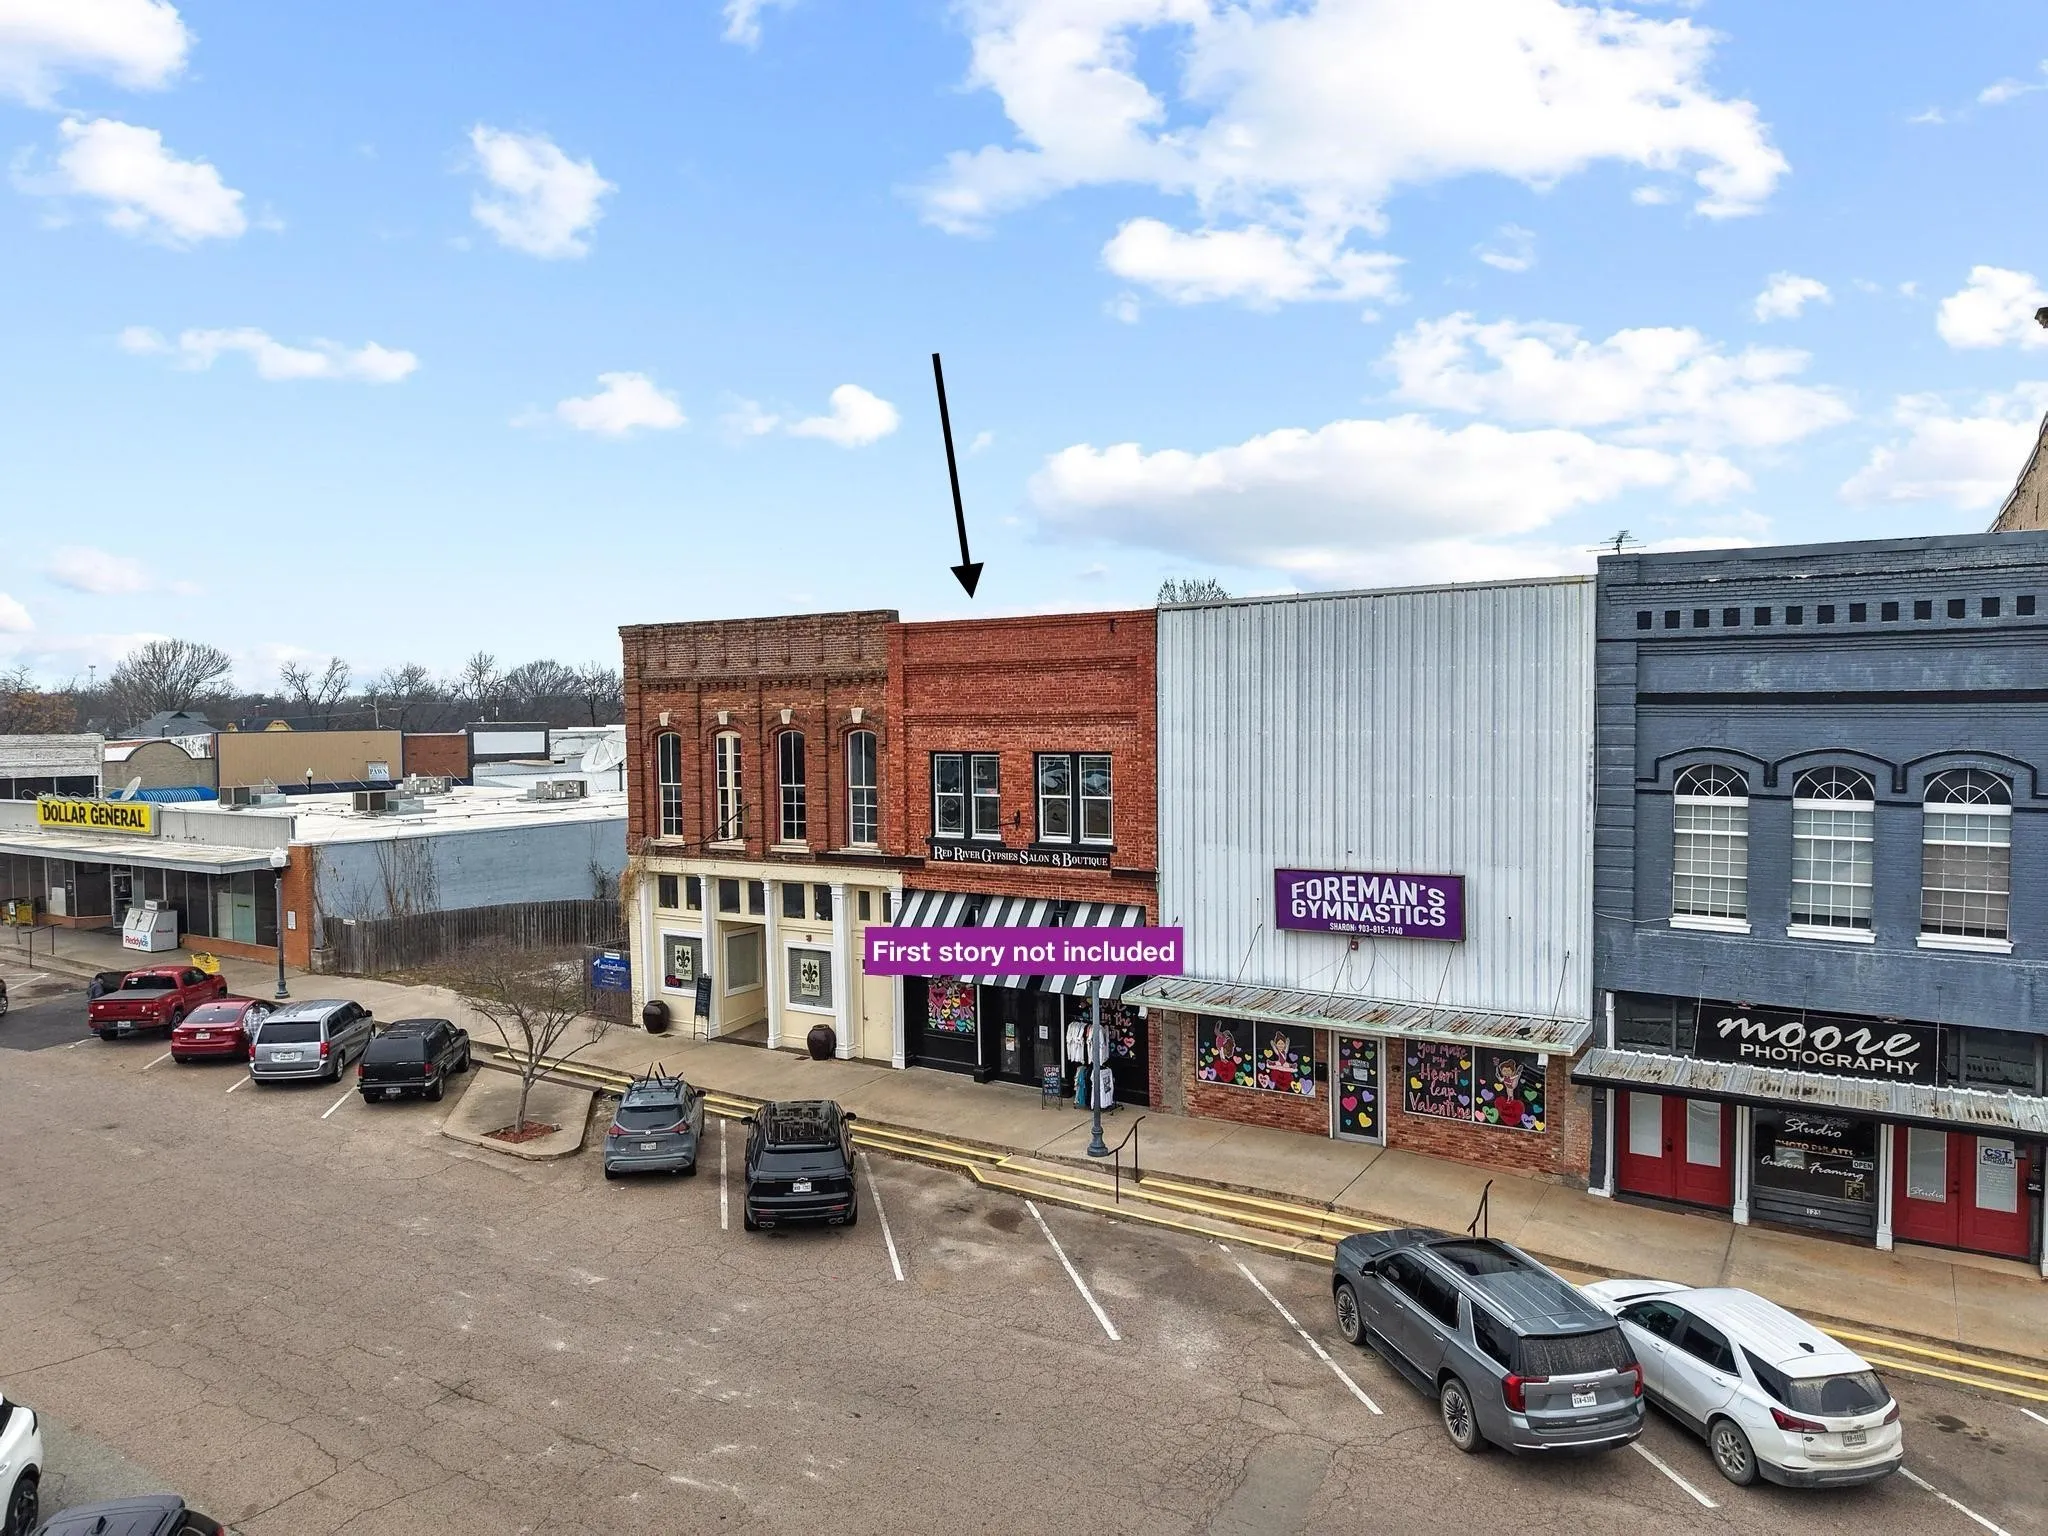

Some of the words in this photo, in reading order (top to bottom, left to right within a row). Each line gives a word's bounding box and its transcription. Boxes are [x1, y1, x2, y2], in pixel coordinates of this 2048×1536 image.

[42, 804, 87, 824] DOLLAR
[90, 806, 145, 828] GENERAL
[1051, 853, 1061, 867] &
[1291, 875, 1446, 907] FOREMAN'S
[1291, 899, 1446, 927] GYMNASTICS
[1358, 923, 1403, 935] 903-815-1740
[1716, 1017, 1921, 1058] moore
[1739, 1043, 1920, 1076] PHOTOGRAPHY
[1419, 1062, 1460, 1085] Heart
[1409, 1091, 1472, 1119] Valentine
[1784, 1118, 1842, 1138] Studio
[1984, 1148, 2011, 1159] CST
[1761, 1155, 1805, 1171] Custom
[1809, 1161, 1865, 1183] Framing
[1853, 1161, 1873, 1170] OPEN
[1910, 1186, 1944, 1200] Studio
